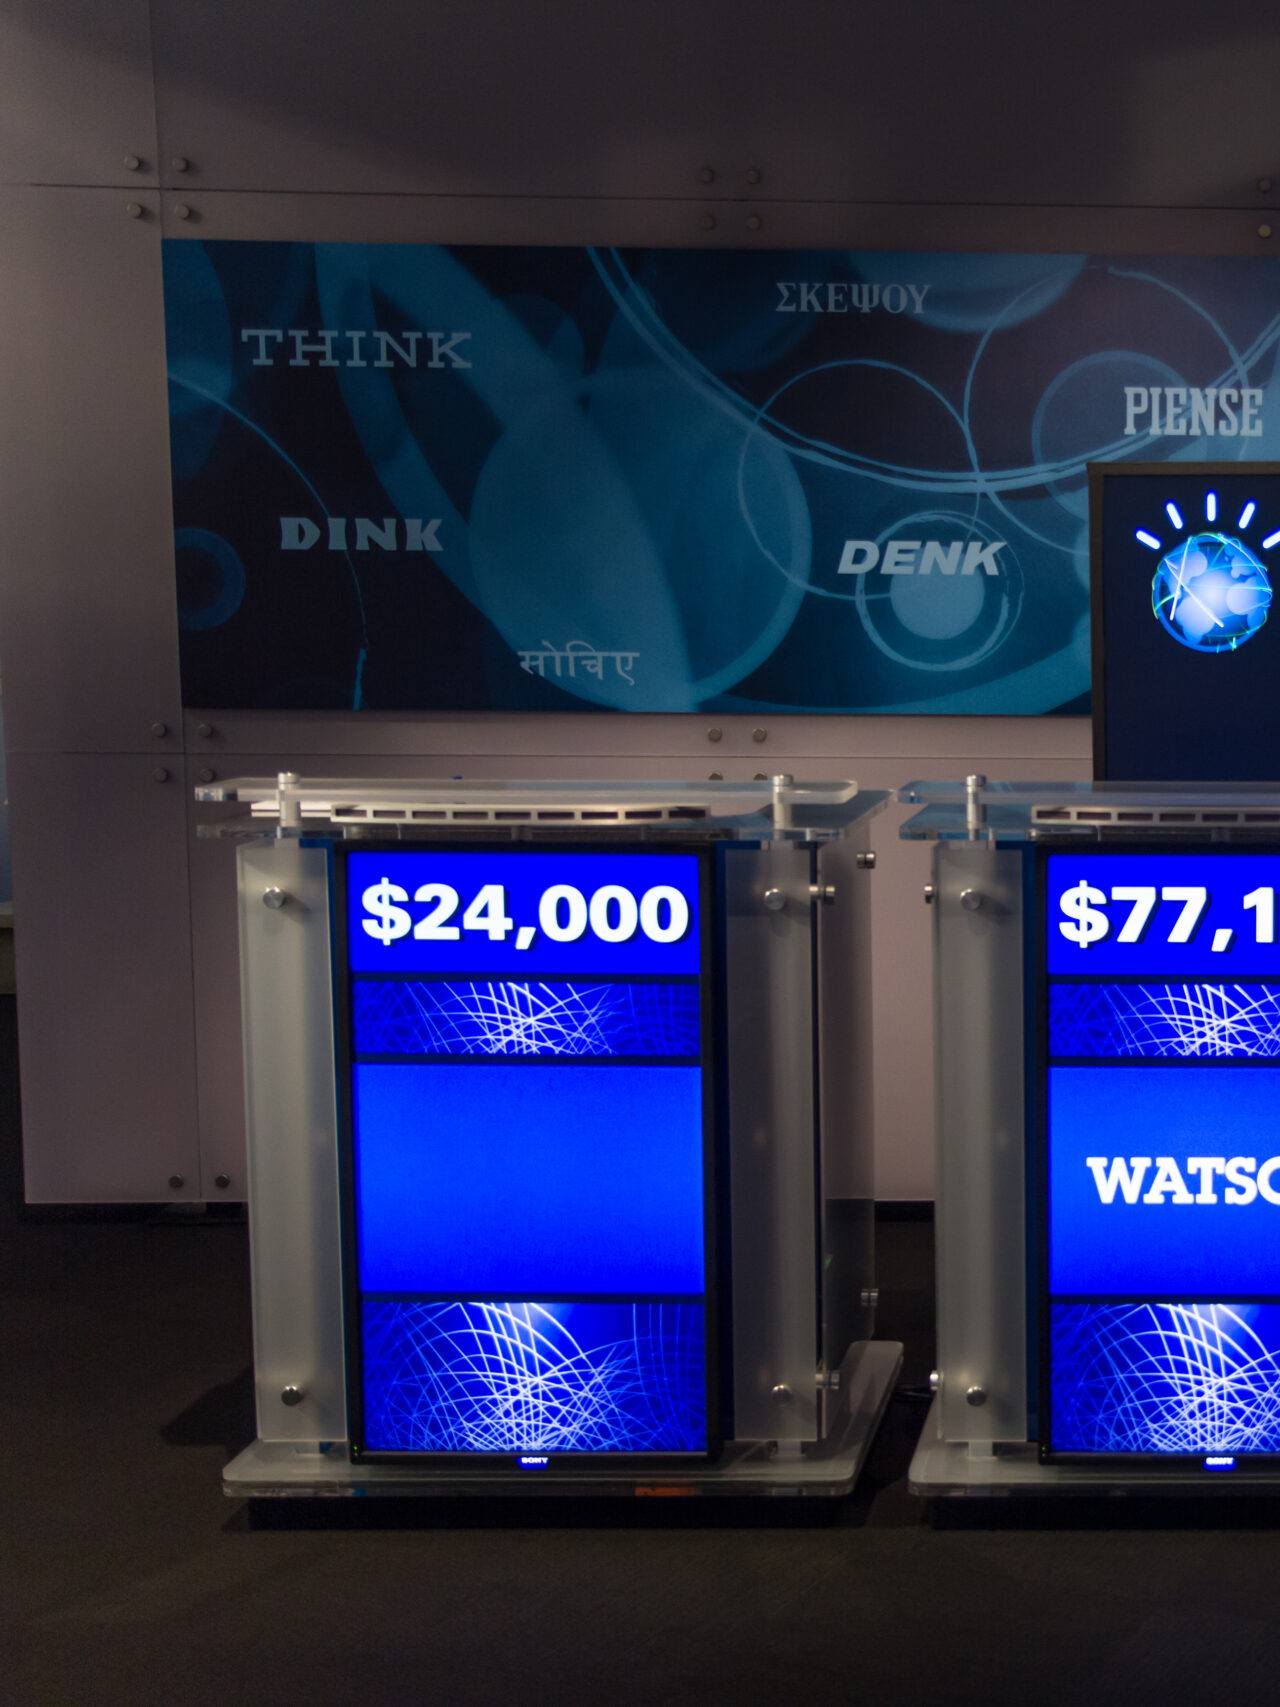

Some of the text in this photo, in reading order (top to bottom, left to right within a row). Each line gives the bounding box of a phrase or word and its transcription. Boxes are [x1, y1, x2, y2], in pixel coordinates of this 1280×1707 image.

[241, 328, 473, 369] THINK
[1124, 386, 1264, 437] PIENSE
[279, 516, 444, 552] DINK
[837, 539, 1008, 577] DENK
[517, 639, 640, 686] सोचिए
[361, 877, 690, 950] $24,000
